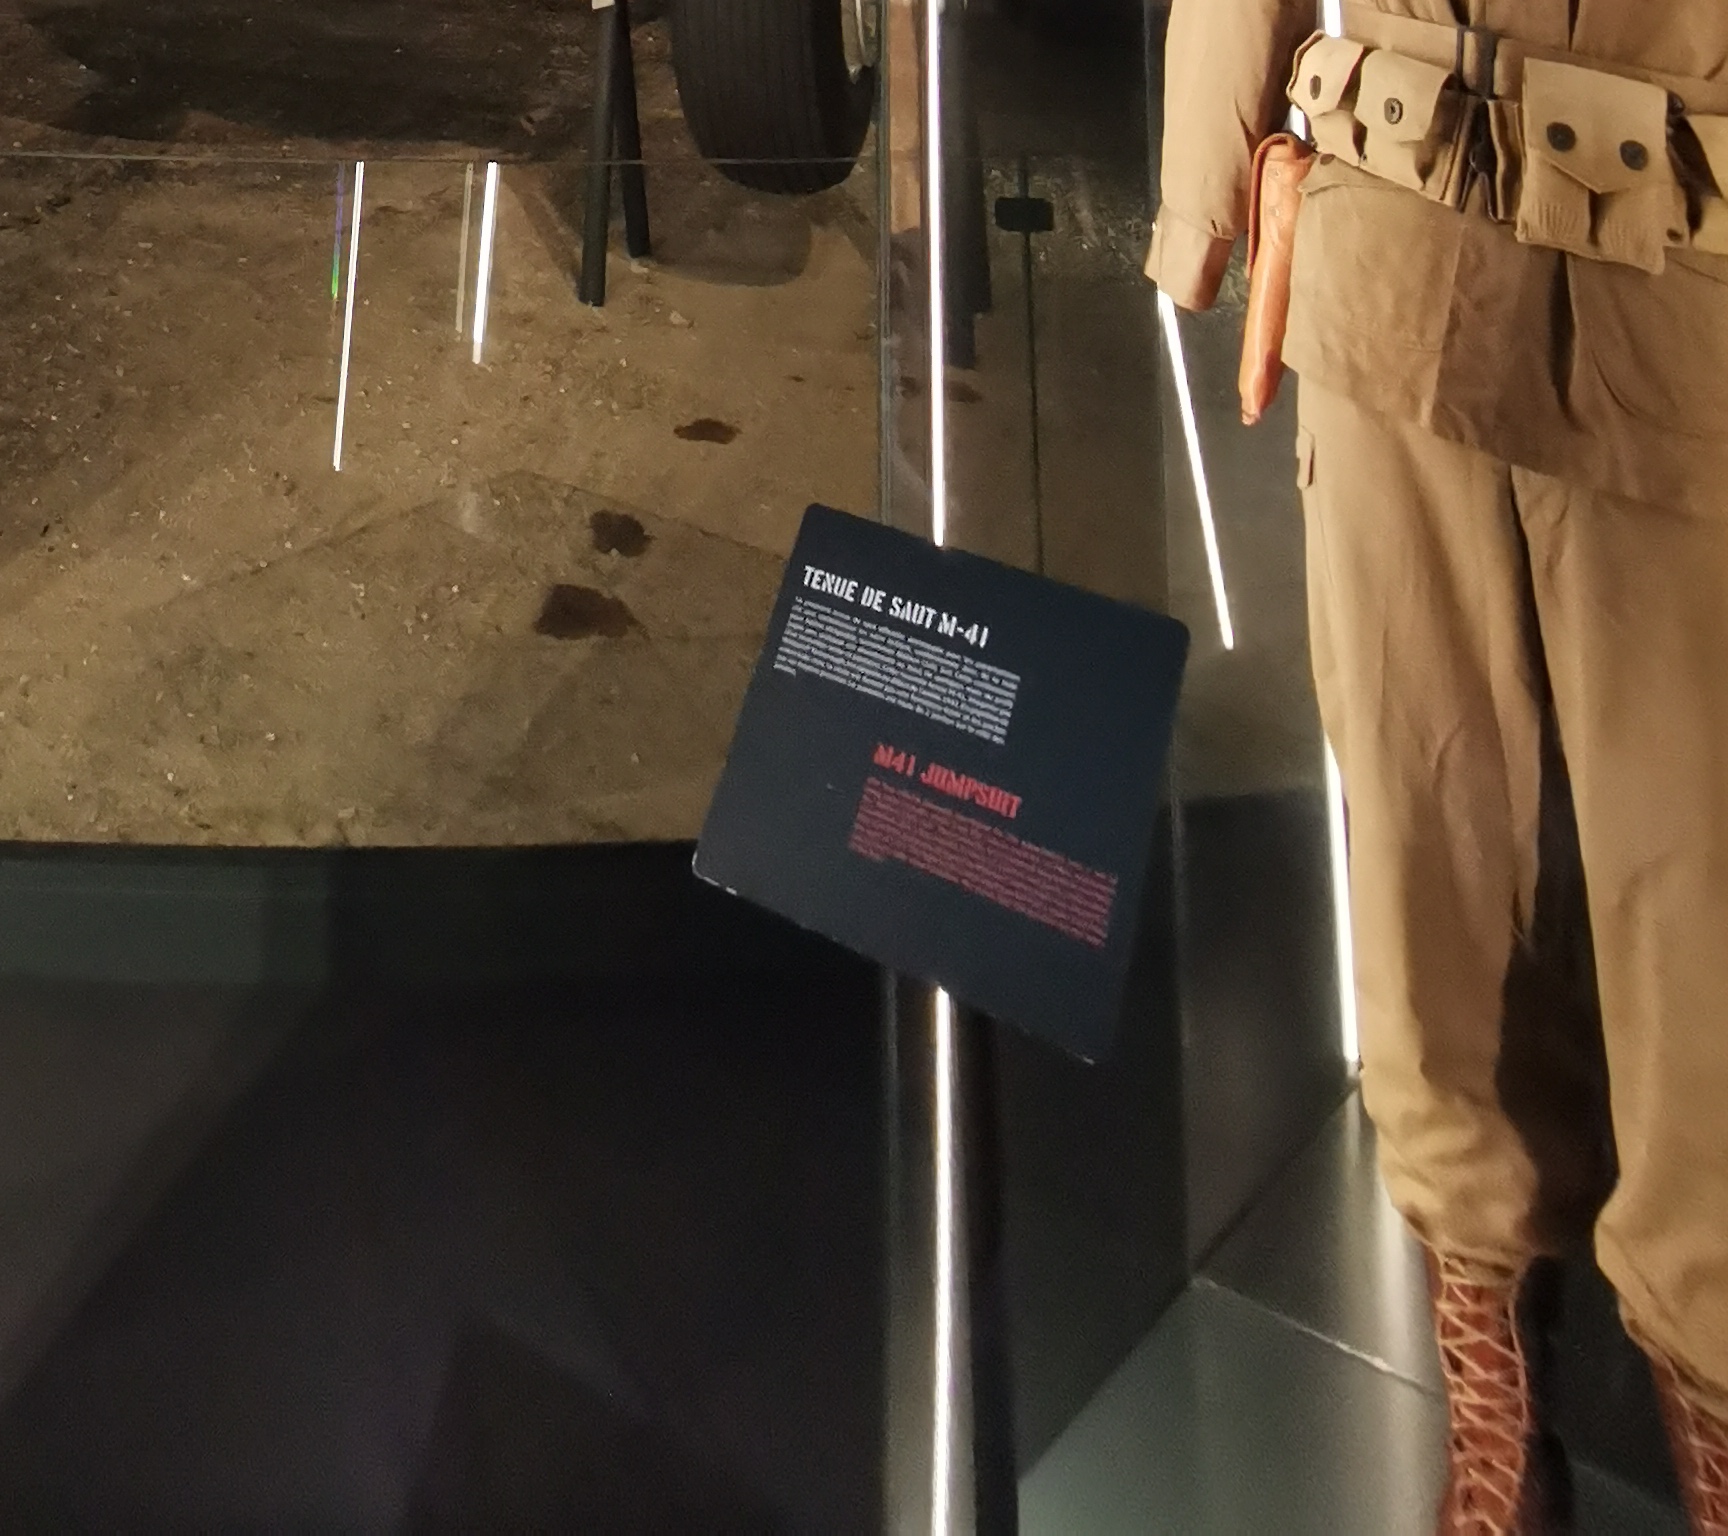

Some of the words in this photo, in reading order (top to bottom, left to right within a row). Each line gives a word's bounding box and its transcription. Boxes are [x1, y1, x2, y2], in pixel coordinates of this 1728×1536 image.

[803, 565, 858, 602] TENUE
[861, 586, 887, 612] DE
[889, 596, 937, 629] SAUT
[937, 611, 989, 648] M-41
[920, 762, 1022, 817] JUMPSUIT
